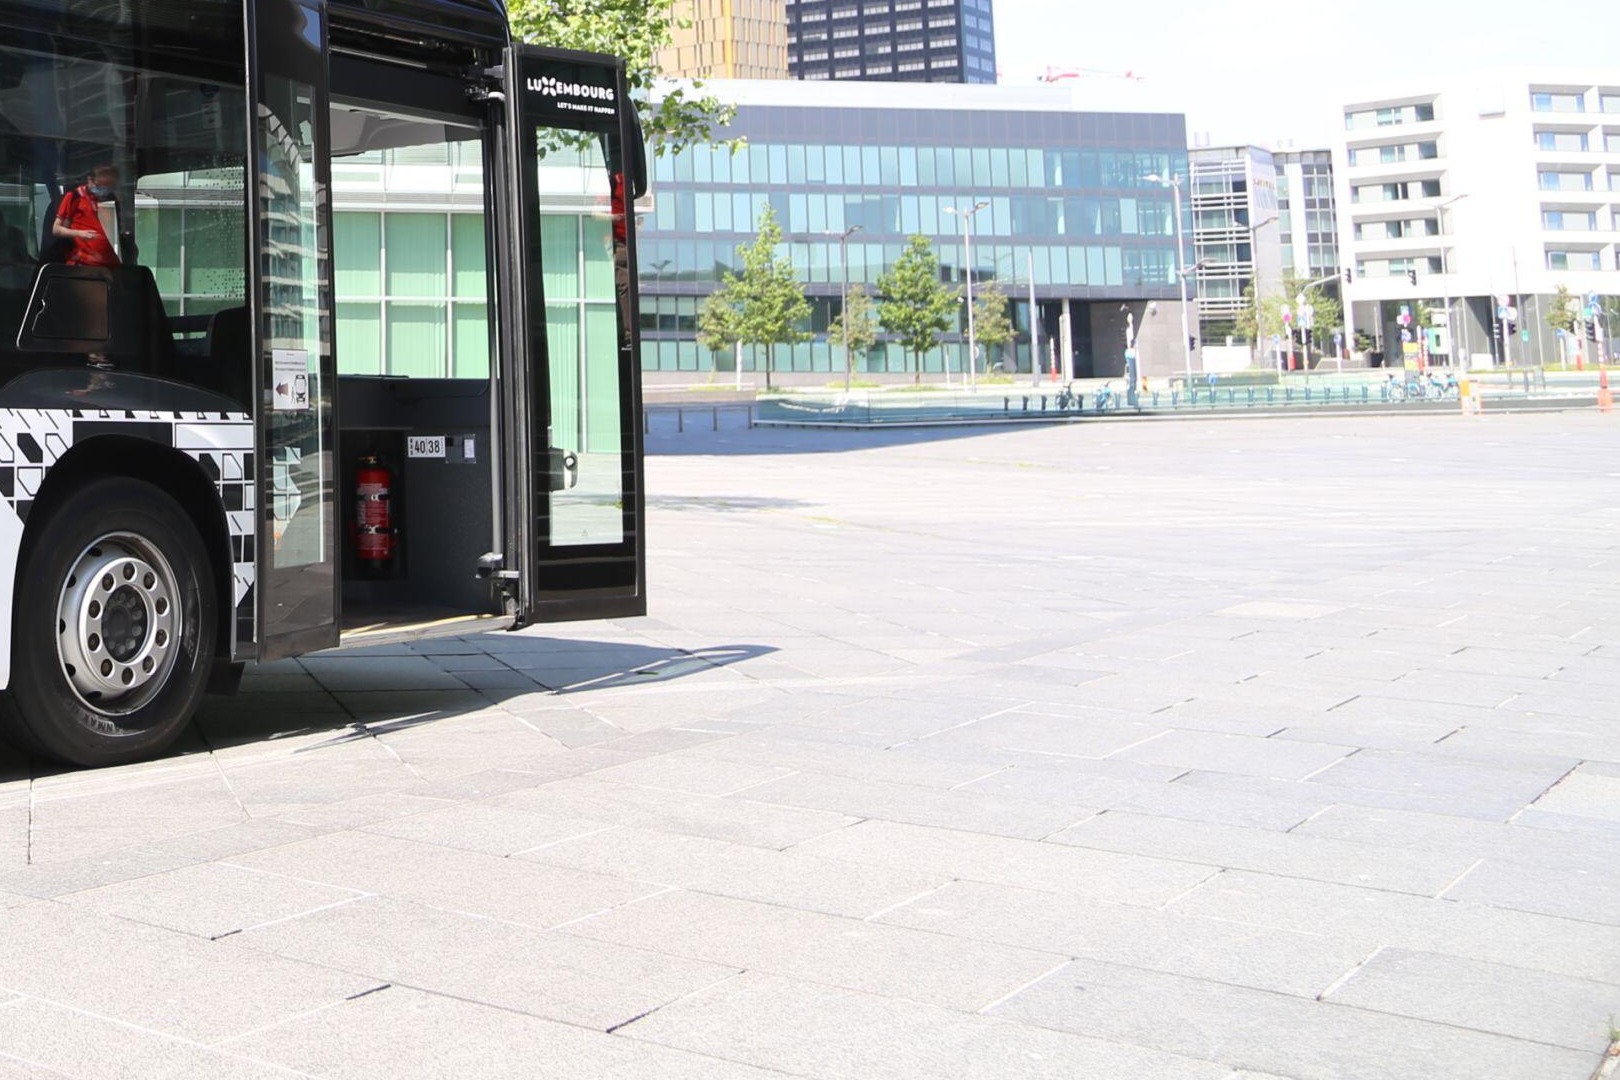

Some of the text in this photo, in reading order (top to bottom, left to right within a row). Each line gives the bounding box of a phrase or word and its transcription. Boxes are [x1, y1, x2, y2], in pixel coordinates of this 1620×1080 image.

[526, 76, 614, 101] LUXEMBOURG
[557, 102, 615, 115] LET'S MAKE IT HAPPEN
